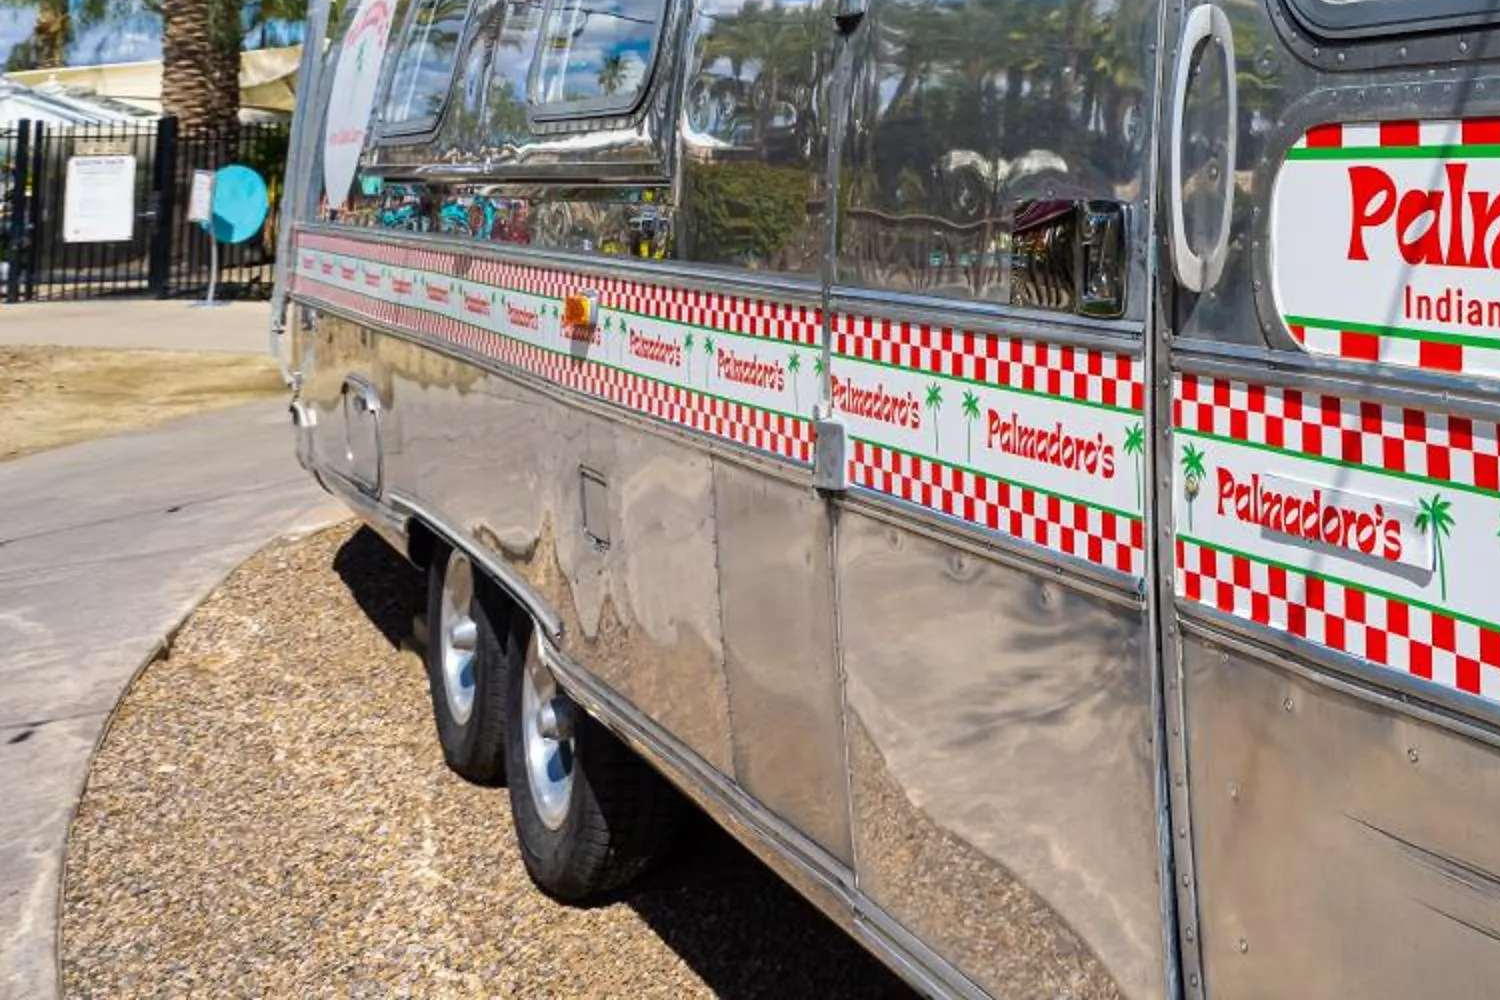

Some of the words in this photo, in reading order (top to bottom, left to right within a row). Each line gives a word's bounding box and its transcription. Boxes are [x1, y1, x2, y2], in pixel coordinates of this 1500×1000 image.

[830, 375, 920, 430] Palmadoro's
[986, 407, 1116, 480] Palmadoro's
[1216, 466, 1402, 562] Palmadoro's
